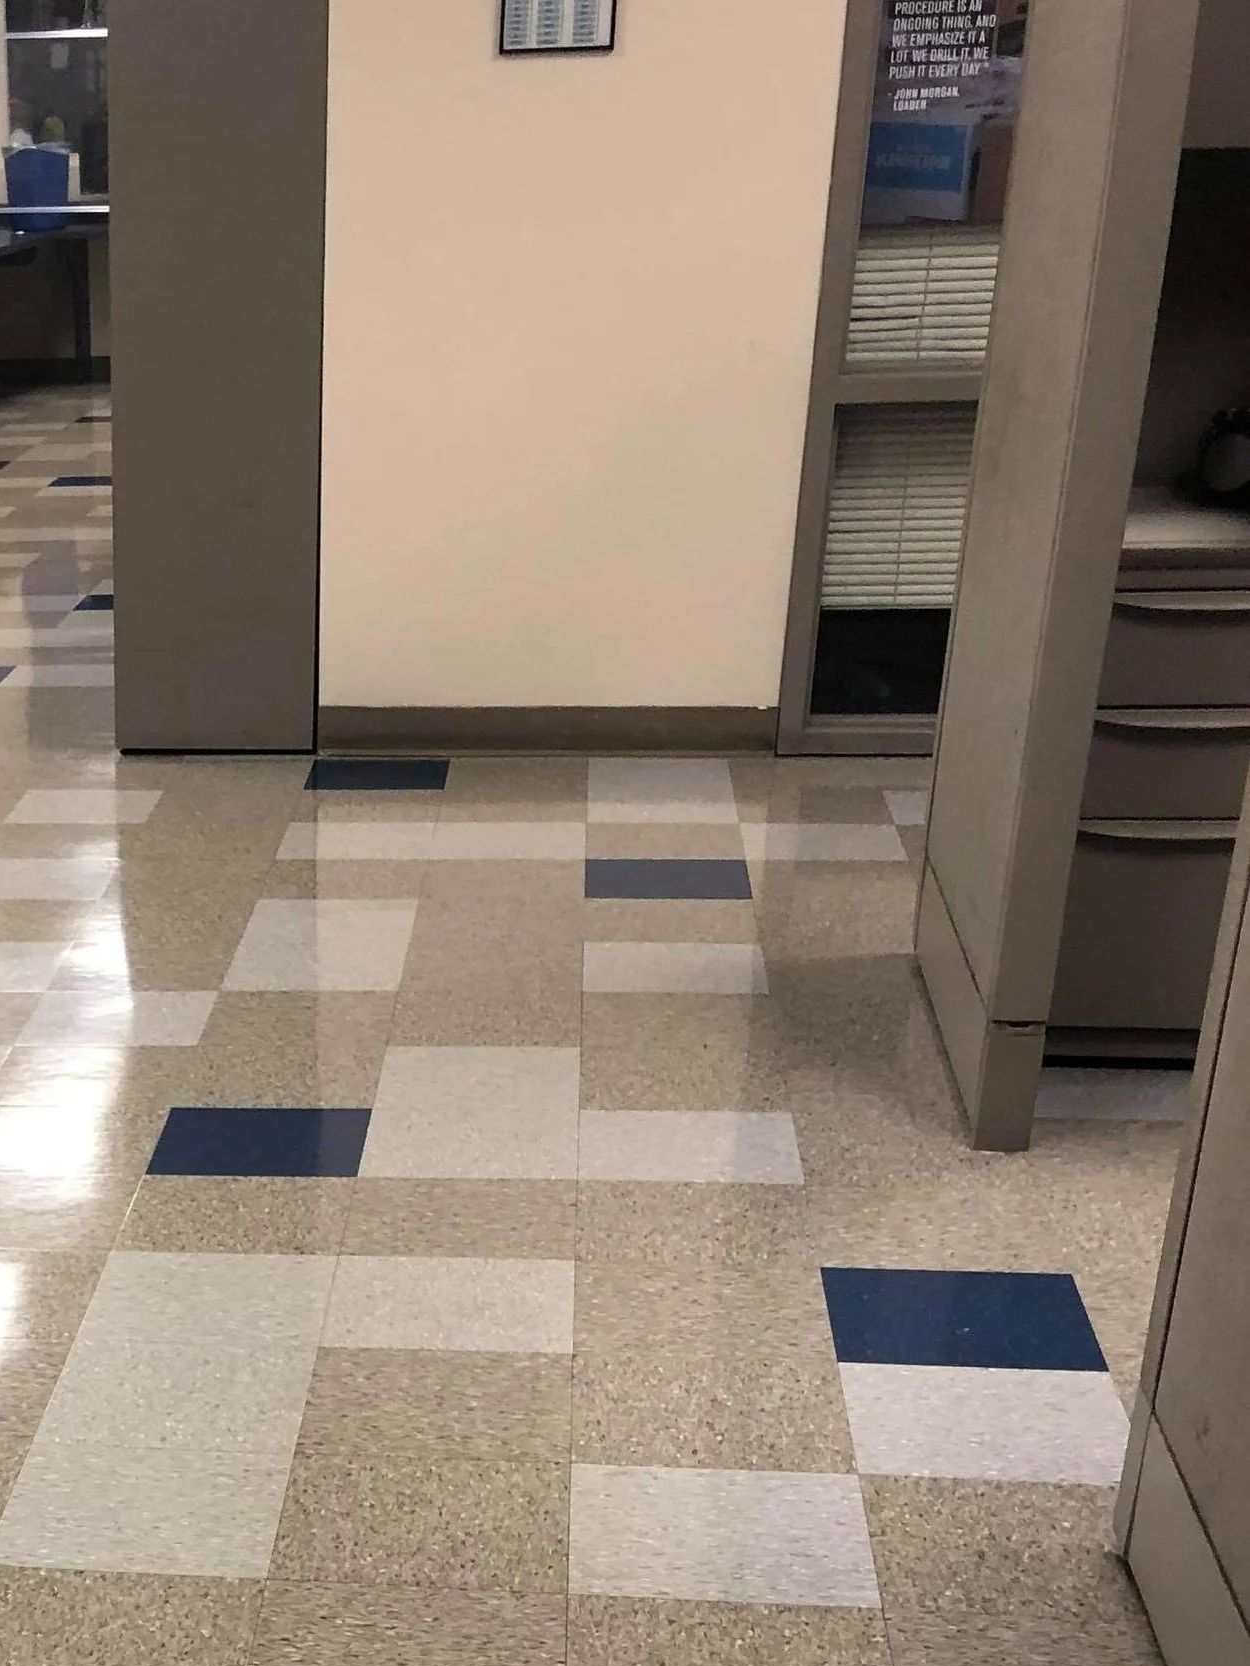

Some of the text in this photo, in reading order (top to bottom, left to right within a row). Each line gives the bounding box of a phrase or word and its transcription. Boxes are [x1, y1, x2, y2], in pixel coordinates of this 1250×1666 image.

[895, 0, 982, 15] PROCEDURE IS AN
[893, 17, 939, 31] ONGOING
[975, 14, 996, 28] AND
[892, 30, 986, 48] WE EMPHASIZE IT A
[912, 48, 928, 62] WE
[930, 47, 959, 62] DRILL
[973, 46, 989, 60] WE
[889, 65, 915, 79] PUSH
[917, 65, 927, 78] IT
[928, 63, 960, 78] EVERY
[894, 88, 918, 100] JOHN
[893, 99, 927, 111] LOADER
